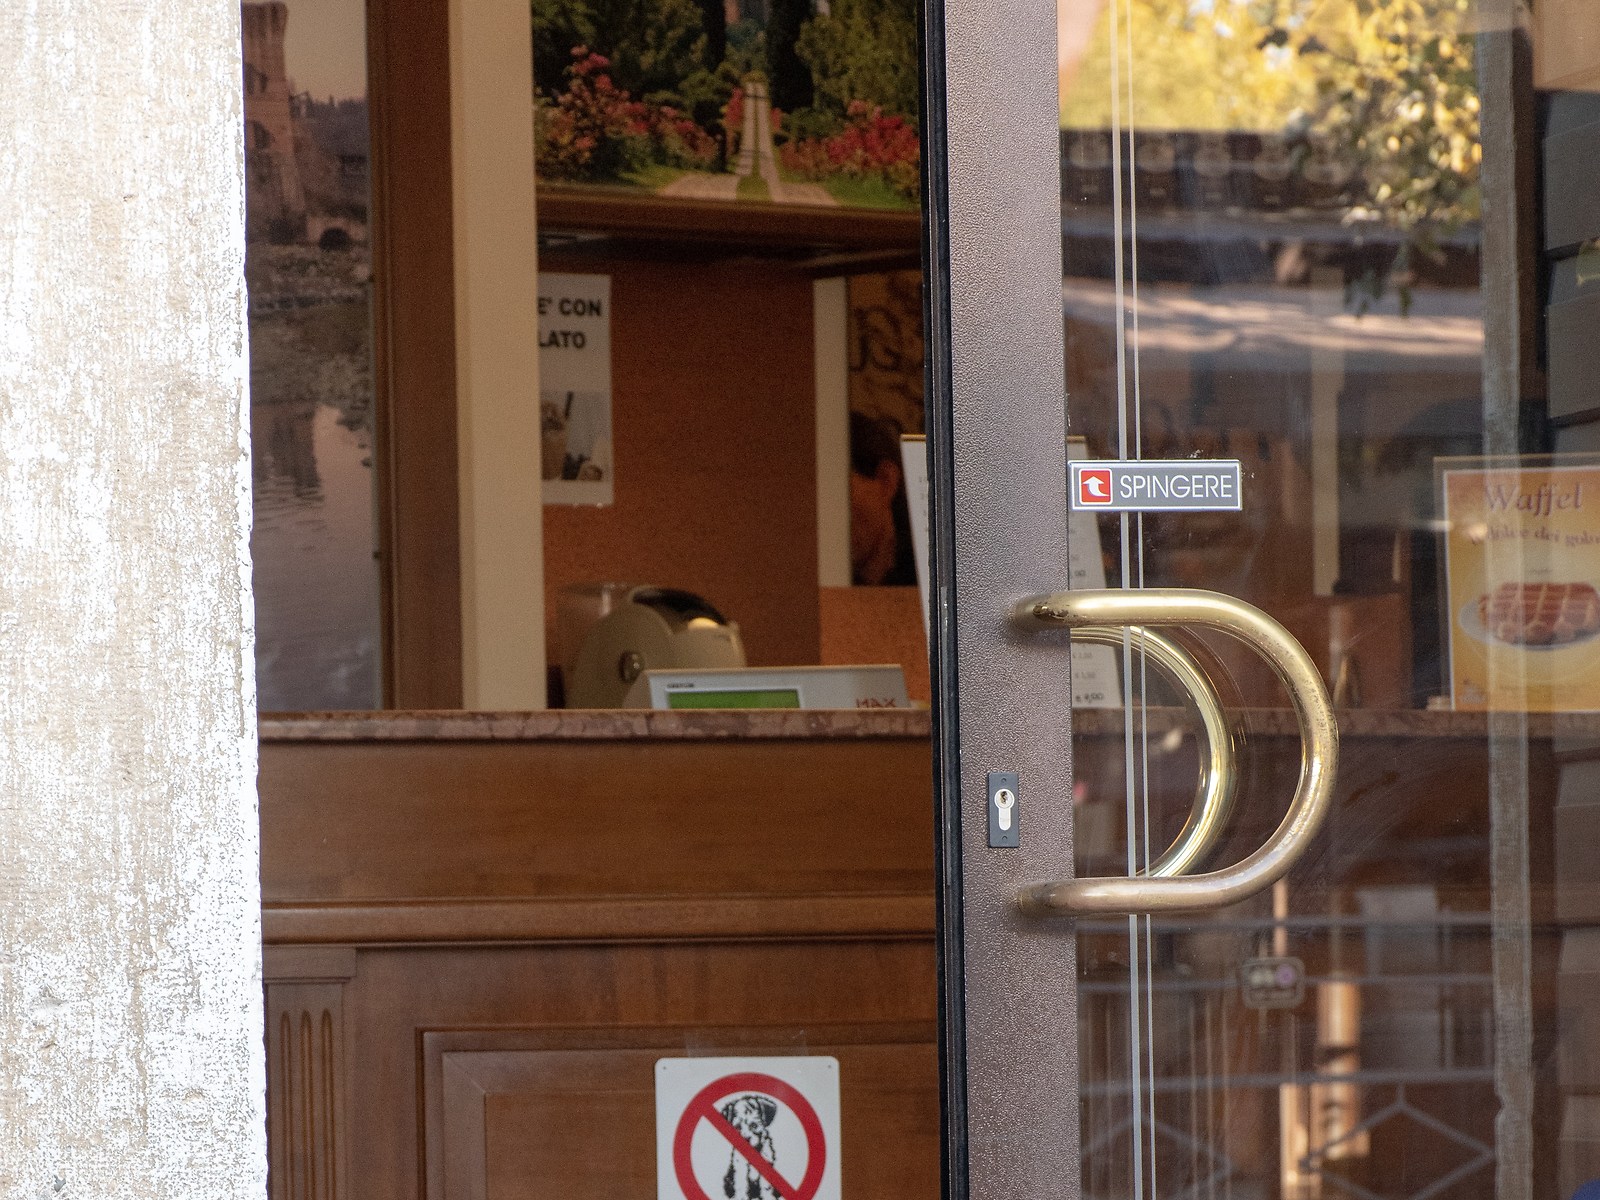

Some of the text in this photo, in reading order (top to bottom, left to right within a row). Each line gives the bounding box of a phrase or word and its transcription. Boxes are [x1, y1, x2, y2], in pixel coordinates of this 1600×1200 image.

[559, 297, 602, 317] CON
[1120, 475, 1232, 499] SPINGERE
[1484, 482, 1582, 517] Waffel
